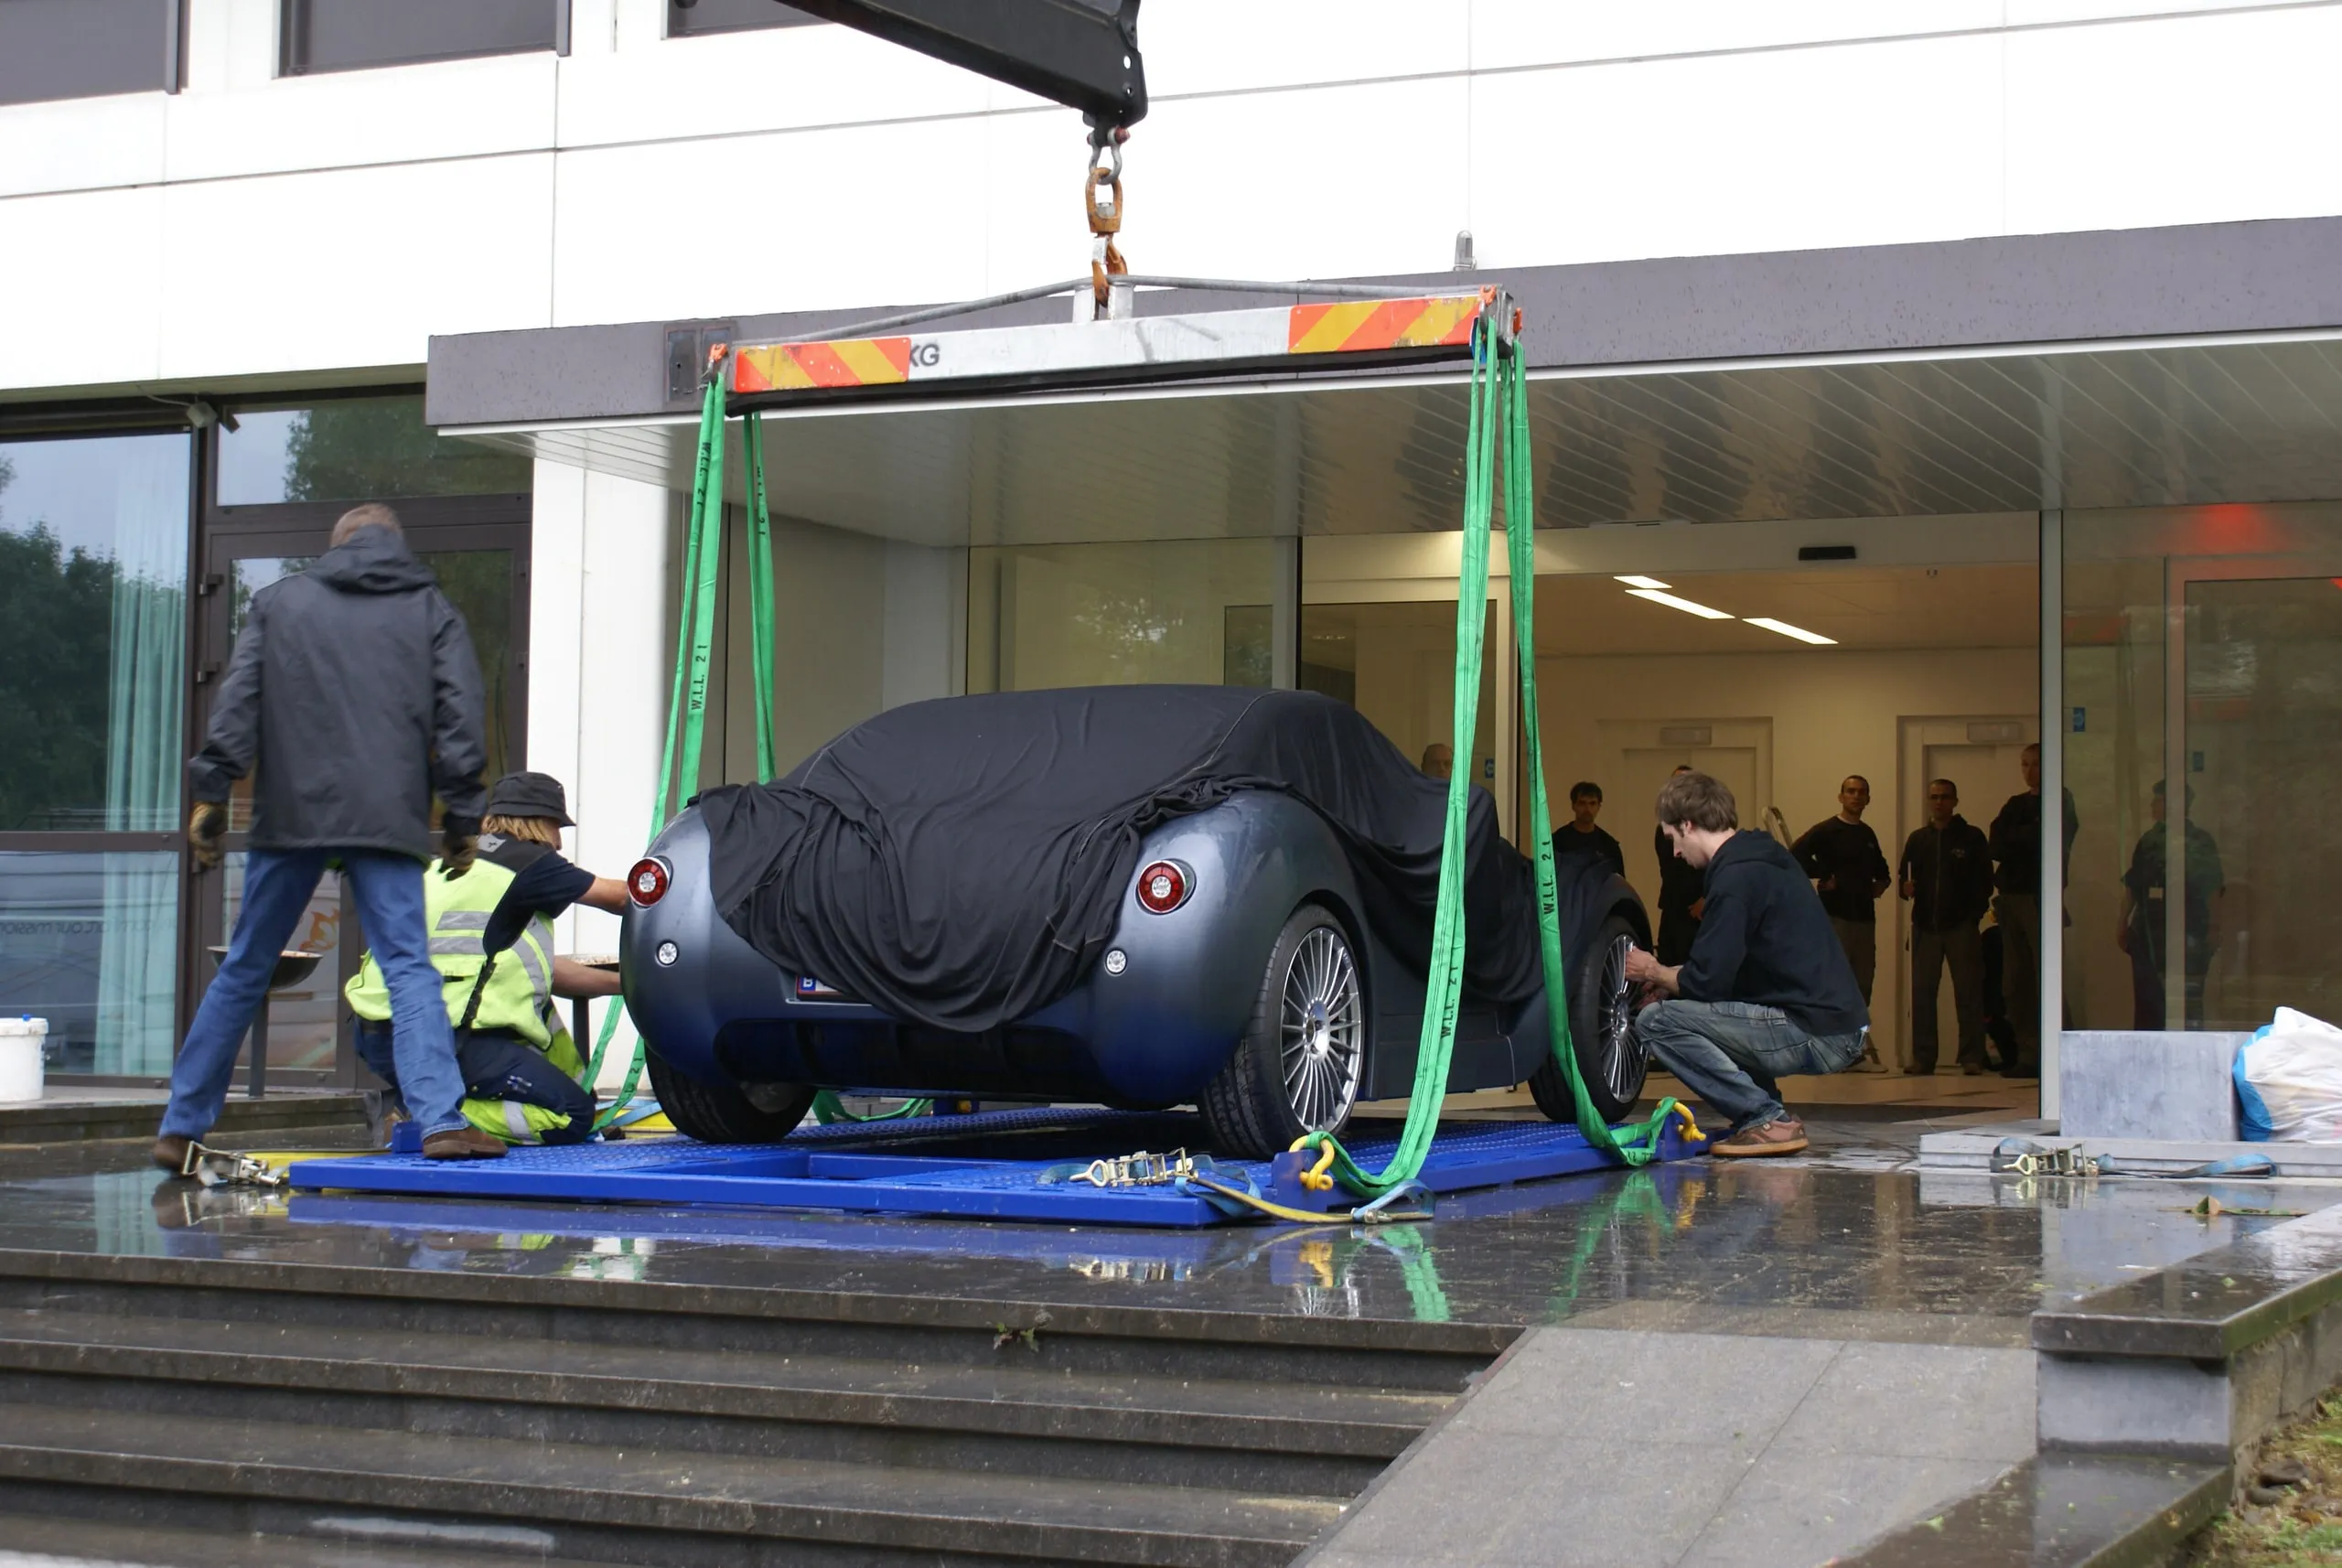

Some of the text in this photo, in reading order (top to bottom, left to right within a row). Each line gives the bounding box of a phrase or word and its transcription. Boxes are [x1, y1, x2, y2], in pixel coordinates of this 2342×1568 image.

[691, 674, 705, 711] W.L.L.
[1542, 874, 1555, 915] W.L.L.
[1441, 998, 1456, 1039] W.L.L.
